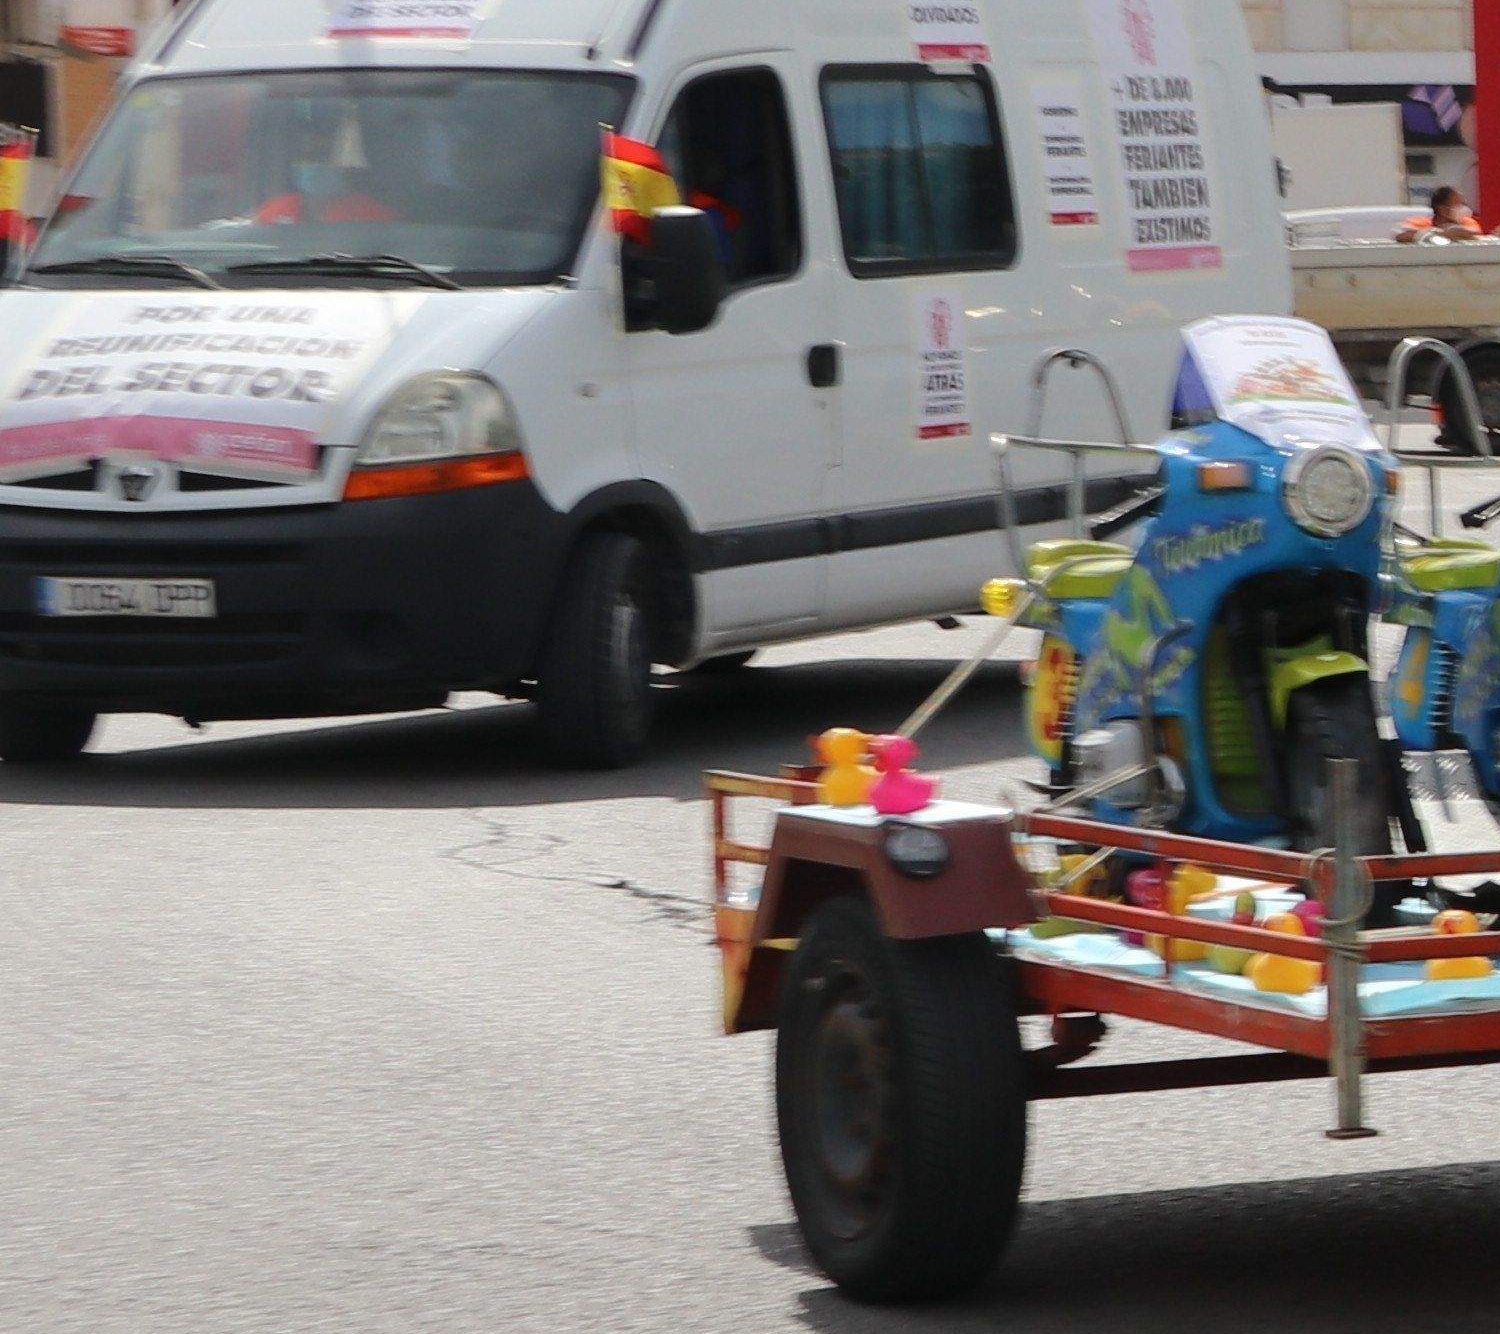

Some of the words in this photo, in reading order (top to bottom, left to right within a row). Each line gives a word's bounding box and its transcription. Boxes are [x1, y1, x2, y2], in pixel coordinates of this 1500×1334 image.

[1117, 109, 1200, 138] EMPRESAS
[1123, 143, 1205, 172] FERIANTES
[117, 361, 336, 403] SECTOR
